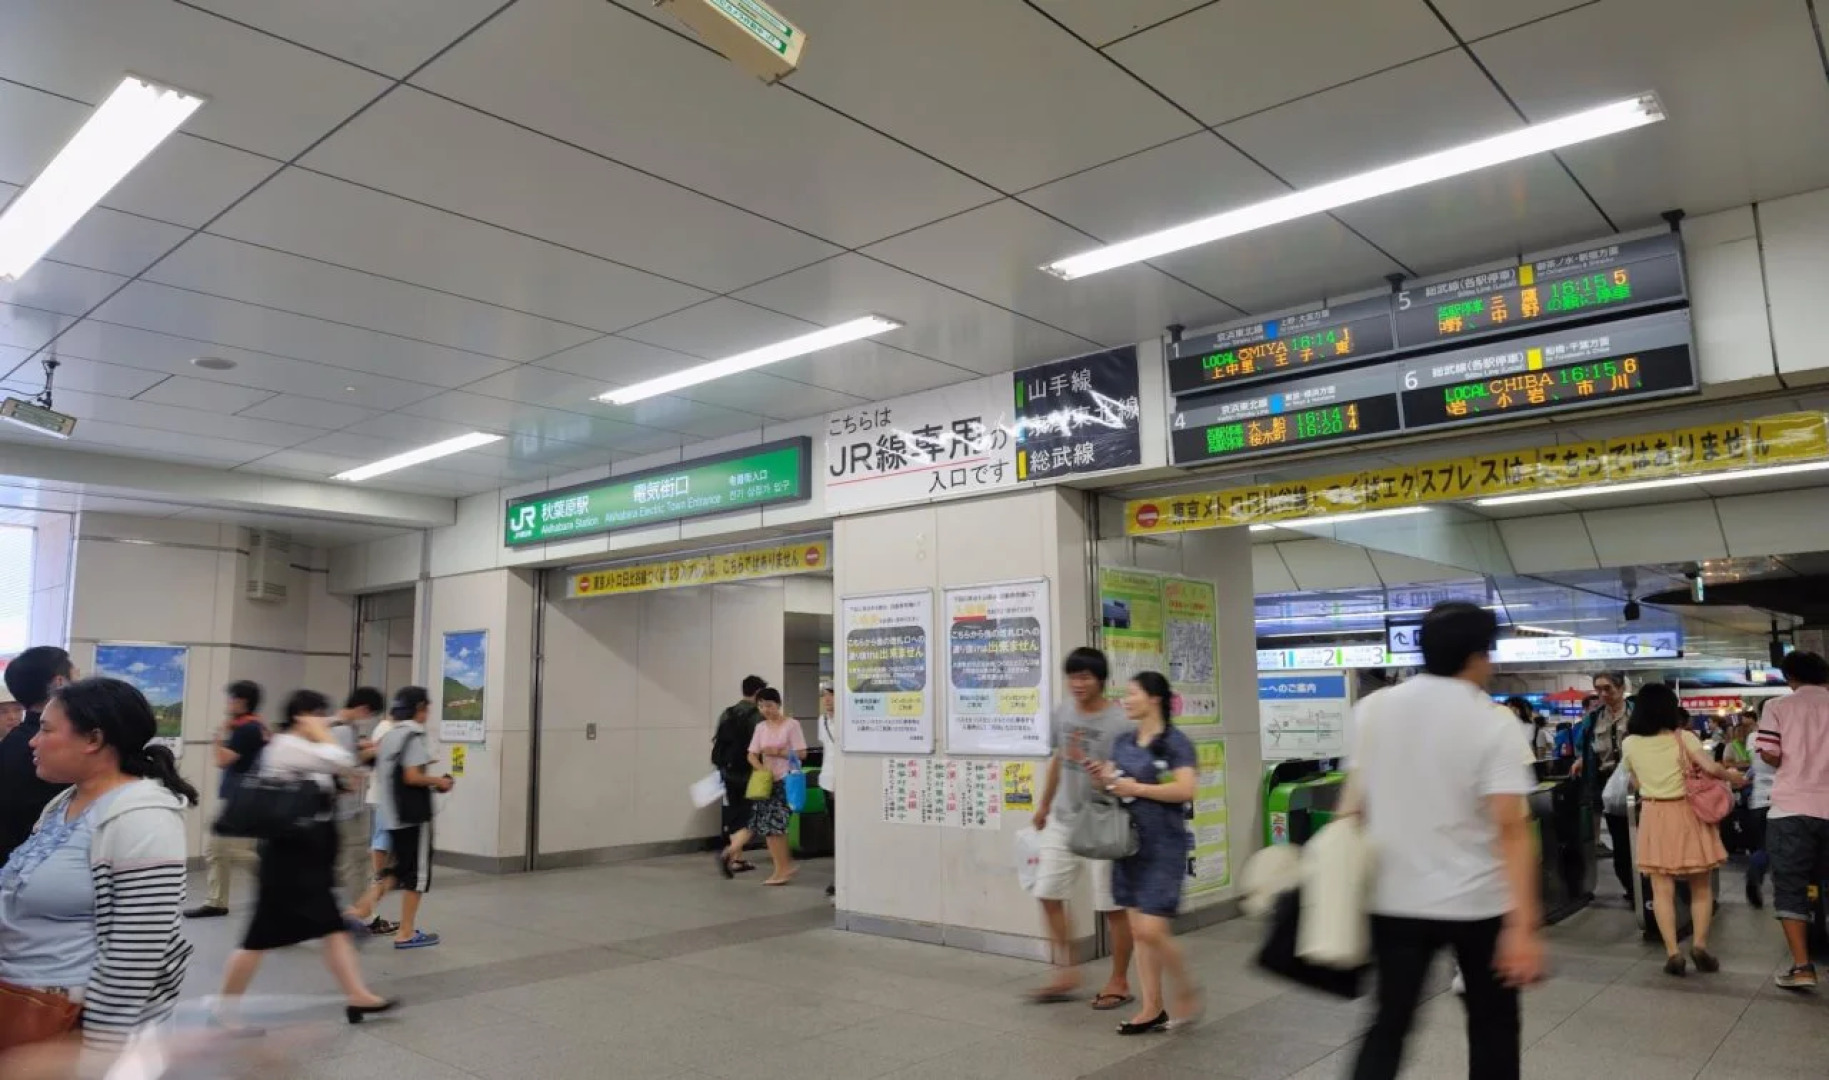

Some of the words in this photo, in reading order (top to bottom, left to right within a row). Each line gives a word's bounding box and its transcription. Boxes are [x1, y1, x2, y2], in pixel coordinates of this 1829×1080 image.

[1552, 273, 1607, 299] 16:15
[1613, 269, 1627, 286] 5
[1399, 292, 1411, 310] 5
[1172, 343, 1180, 358] 1
[1203, 351, 1239, 369] LOCAL
[1238, 340, 1288, 361] OMIYA
[1342, 327, 1350, 342] 1
[1028, 368, 1092, 400] 山手線
[1404, 371, 1418, 389] 6
[1445, 382, 1490, 402] LOCAL
[1490, 373, 1554, 393] CHIBA
[1559, 361, 1617, 384] 16:15
[1623, 358, 1637, 374] 6
[830, 406, 892, 436] こちらは
[1174, 413, 1186, 428] 4
[1347, 403, 1357, 417] 4
[1347, 417, 1359, 431] 4
[1029, 440, 1096, 474] 総武線
[632, 475, 689, 504] 電気街口
[929, 460, 1010, 494] 入口です
[510, 505, 536, 532] JR
[1280, 651, 1287, 668] 1
[1324, 649, 1335, 666] 2
[1373, 646, 1384, 665] 3
[1559, 638, 1573, 658] 5
[1624, 635, 1639, 656] 6
